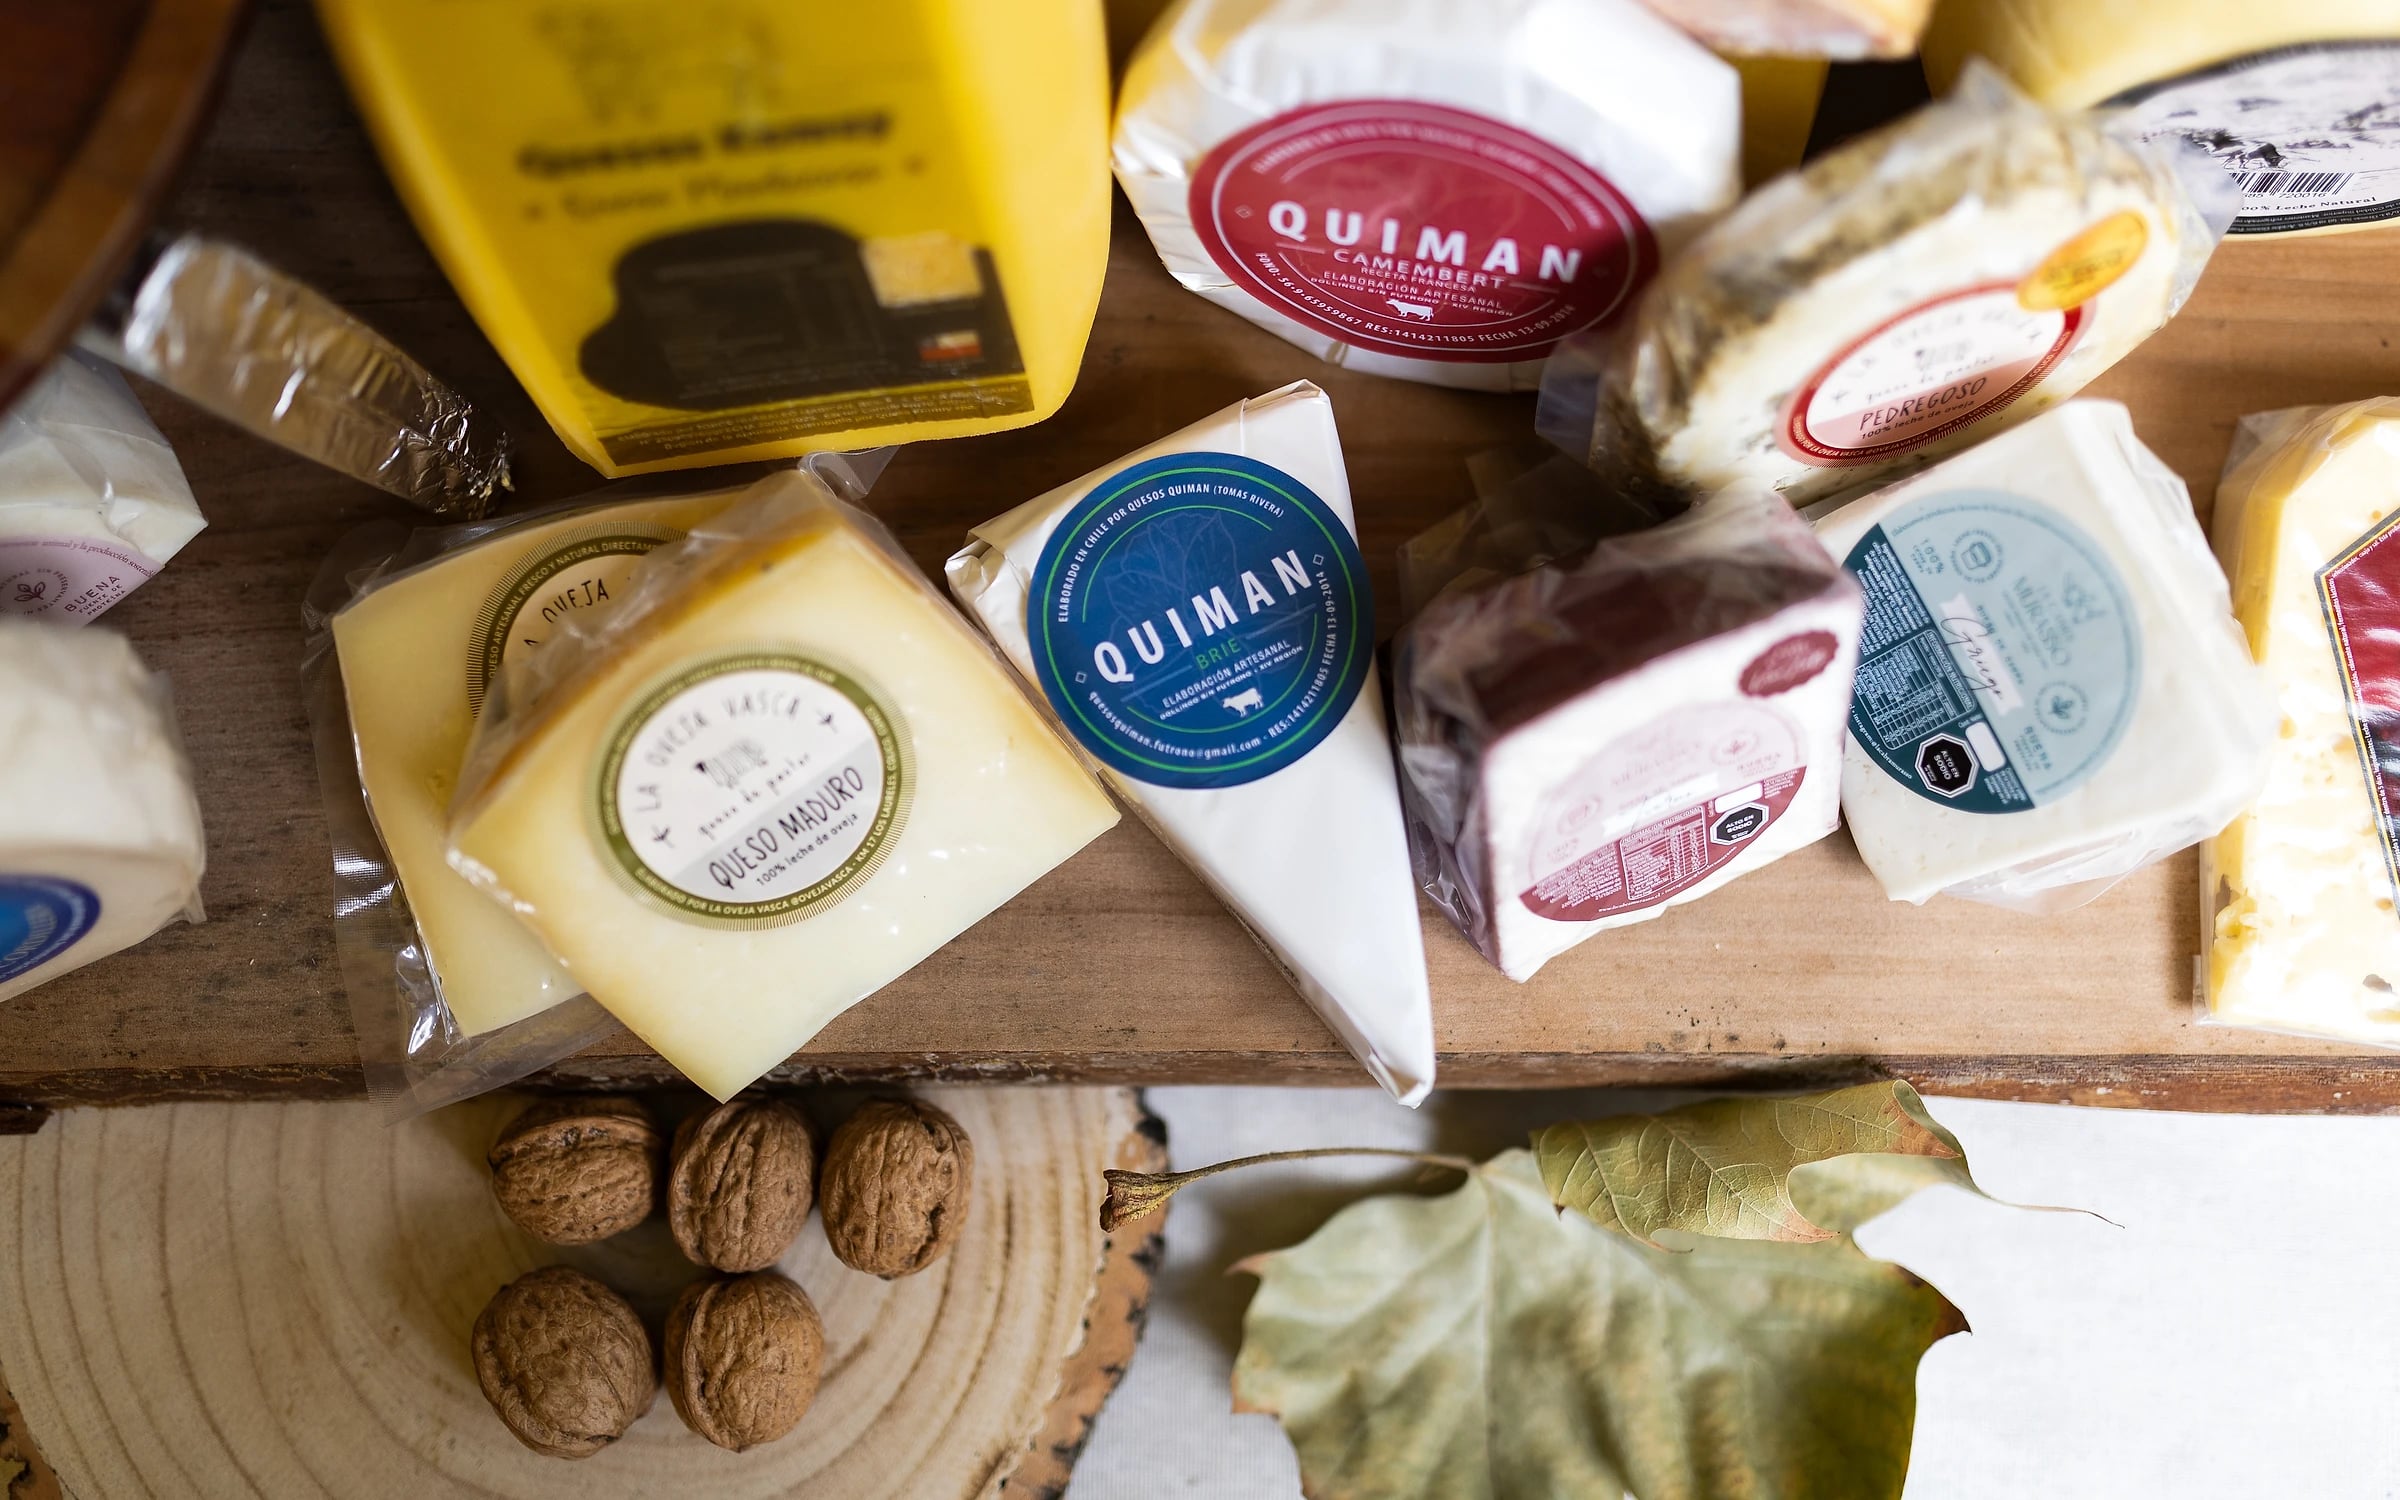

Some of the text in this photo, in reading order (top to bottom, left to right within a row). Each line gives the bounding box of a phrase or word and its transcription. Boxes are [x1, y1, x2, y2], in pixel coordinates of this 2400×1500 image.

[2276, 203, 2316, 211] Leche
[2320, 196, 2377, 207] Natural
[1268, 200, 1582, 283] QUIMAN
[1333, 249, 1505, 289] CAMEMBERT
[1361, 267, 1476, 292] RECETA FRANCESA
[1255, 252, 1281, 276] FONO:
[1478, 331, 1520, 342] FECHA
[1518, 304, 1576, 335] 13-09-2014
[1323, 272, 1502, 309] ELABORACIÓN ARTESANAL
[1860, 377, 1987, 431] PEDREGOSO
[1861, 400, 1976, 439] 100% leche de oveja
[1058, 484, 1284, 622] ELABORADO EN CHILE POR QUESOS QUIMAN (TOMAS RIVERA)
[64, 575, 120, 612] BUENA
[78, 584, 123, 613] FUENTE DE
[489, 644, 501, 680] QUESO
[495, 595, 524, 644] ARTESANAL
[519, 567, 550, 596] FRESCO
[548, 561, 556, 570] Y
[556, 545, 602, 565] NATURAL
[1316, 571, 1337, 629] 13-09-2014
[1094, 549, 1312, 683] QUIMAN
[1195, 638, 1242, 670] BRIE
[1322, 632, 1336, 665] FECHA
[1162, 639, 1291, 708] ELABORACIÓN ARTESANAL
[1088, 691, 1261, 760] quesosquiman.futrono@gmail.com
[1932, 754, 1951, 780] SODIO
[1940, 749, 1960, 778] ALTO EN
[709, 767, 863, 889] QUESO MADURO
[1725, 819, 1744, 828] ALTO
[1726, 820, 1753, 833] SODIO
[686, 899, 707, 910] POR
[708, 905, 721, 913] LA
[723, 906, 755, 915] OVEJA
[757, 899, 789, 914] VASCA
[790, 865, 853, 906] @OVEJAVASCA
[856, 847, 870, 863] KM
[868, 838, 877, 849] 17
[875, 820, 887, 837] LOS
[757, 813, 858, 885] 100% leche de oveja
